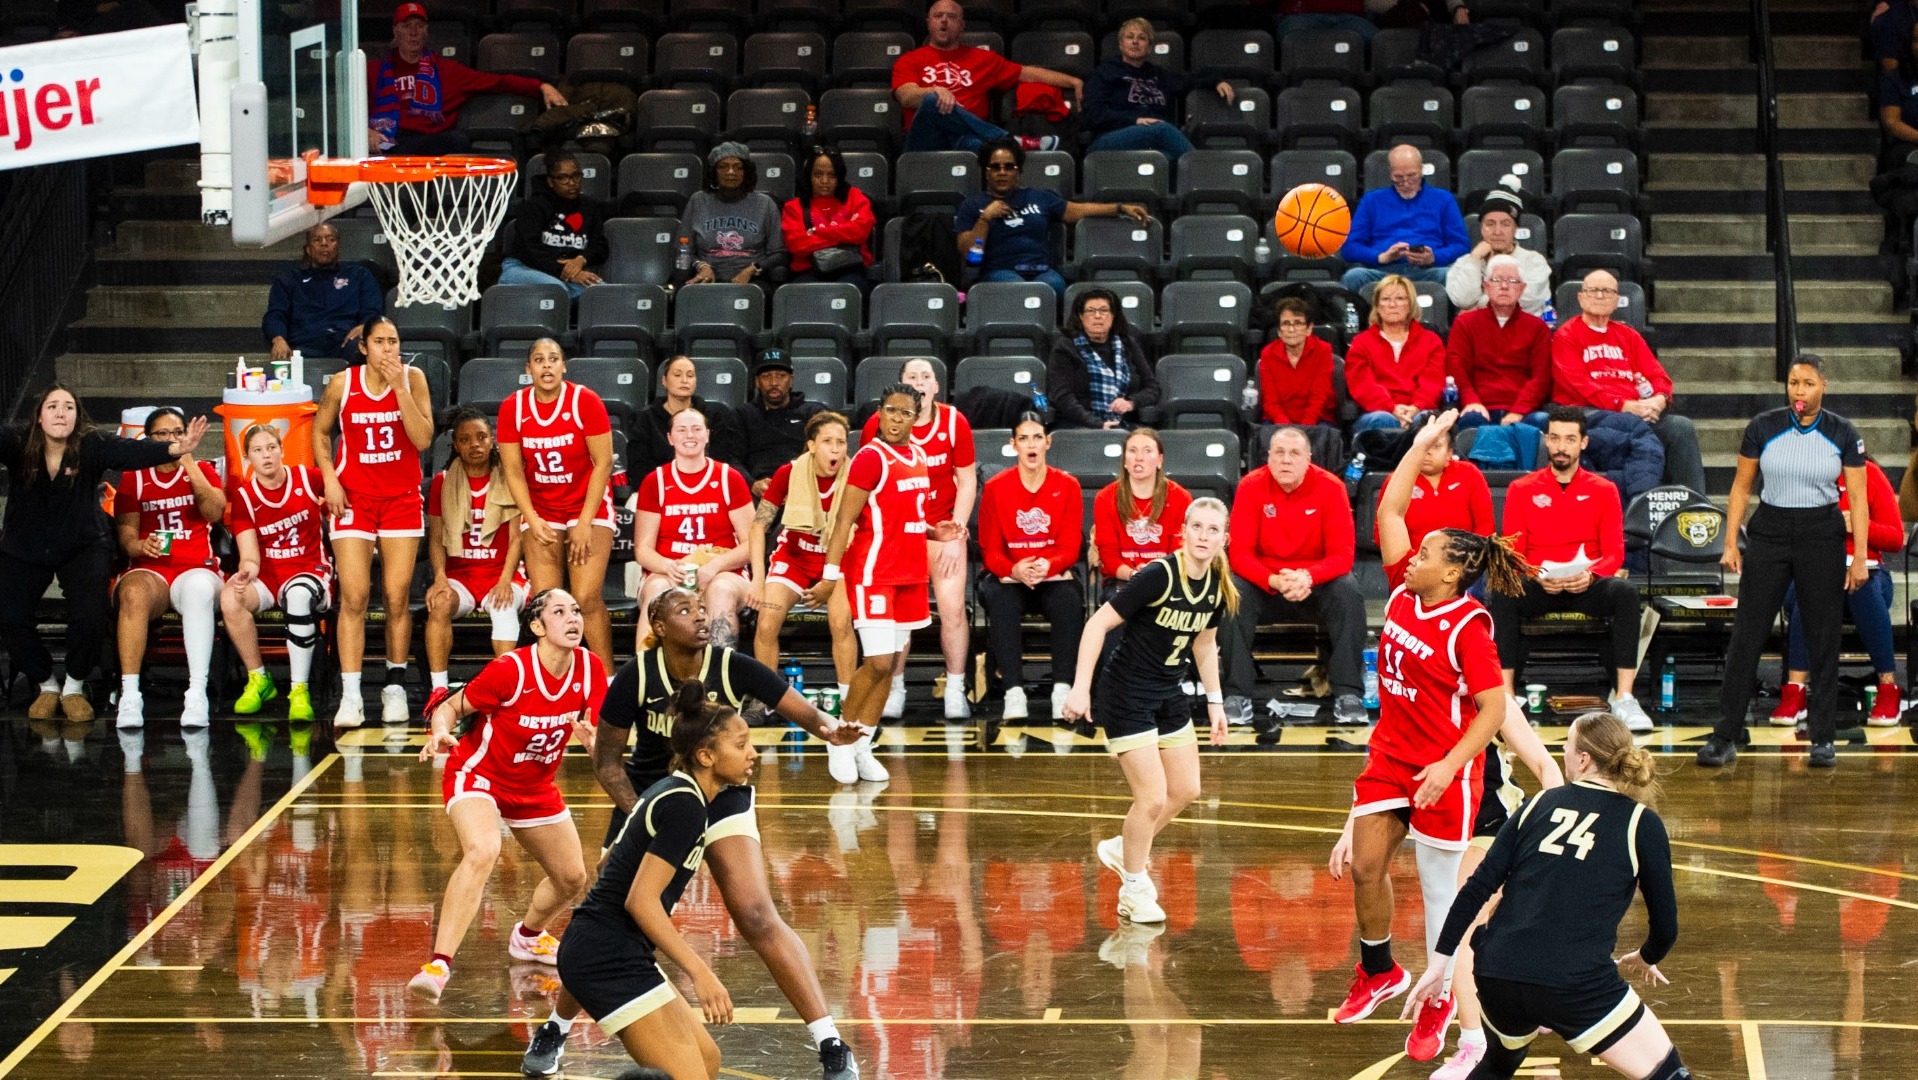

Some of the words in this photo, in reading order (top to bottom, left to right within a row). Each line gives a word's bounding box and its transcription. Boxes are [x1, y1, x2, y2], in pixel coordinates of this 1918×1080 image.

[922, 66, 973, 87] 313
[705, 216, 759, 234] TITANS
[365, 426, 394, 451] 13
[522, 433, 574, 449] DETROIT
[359, 450, 402, 464] MERCY
[534, 451, 564, 472] 12
[534, 471, 573, 484] MERCY
[142, 494, 195, 512] DETROIT
[1646, 491, 1689, 501] HENRY
[665, 503, 719, 517] DETROIT
[157, 511, 184, 532] 15
[259, 509, 310, 536] DETROIT
[678, 516, 706, 541] 41
[265, 546, 306, 559] MERCY
[1155, 606, 1214, 633] OAKLAN
[1383, 618, 1435, 661] ETROIT
[1164, 635, 1190, 666] 2
[1384, 643, 1405, 681] 11
[525, 729, 565, 753] 23
[513, 749, 561, 765] MERCY
[1538, 807, 1601, 861] 24
